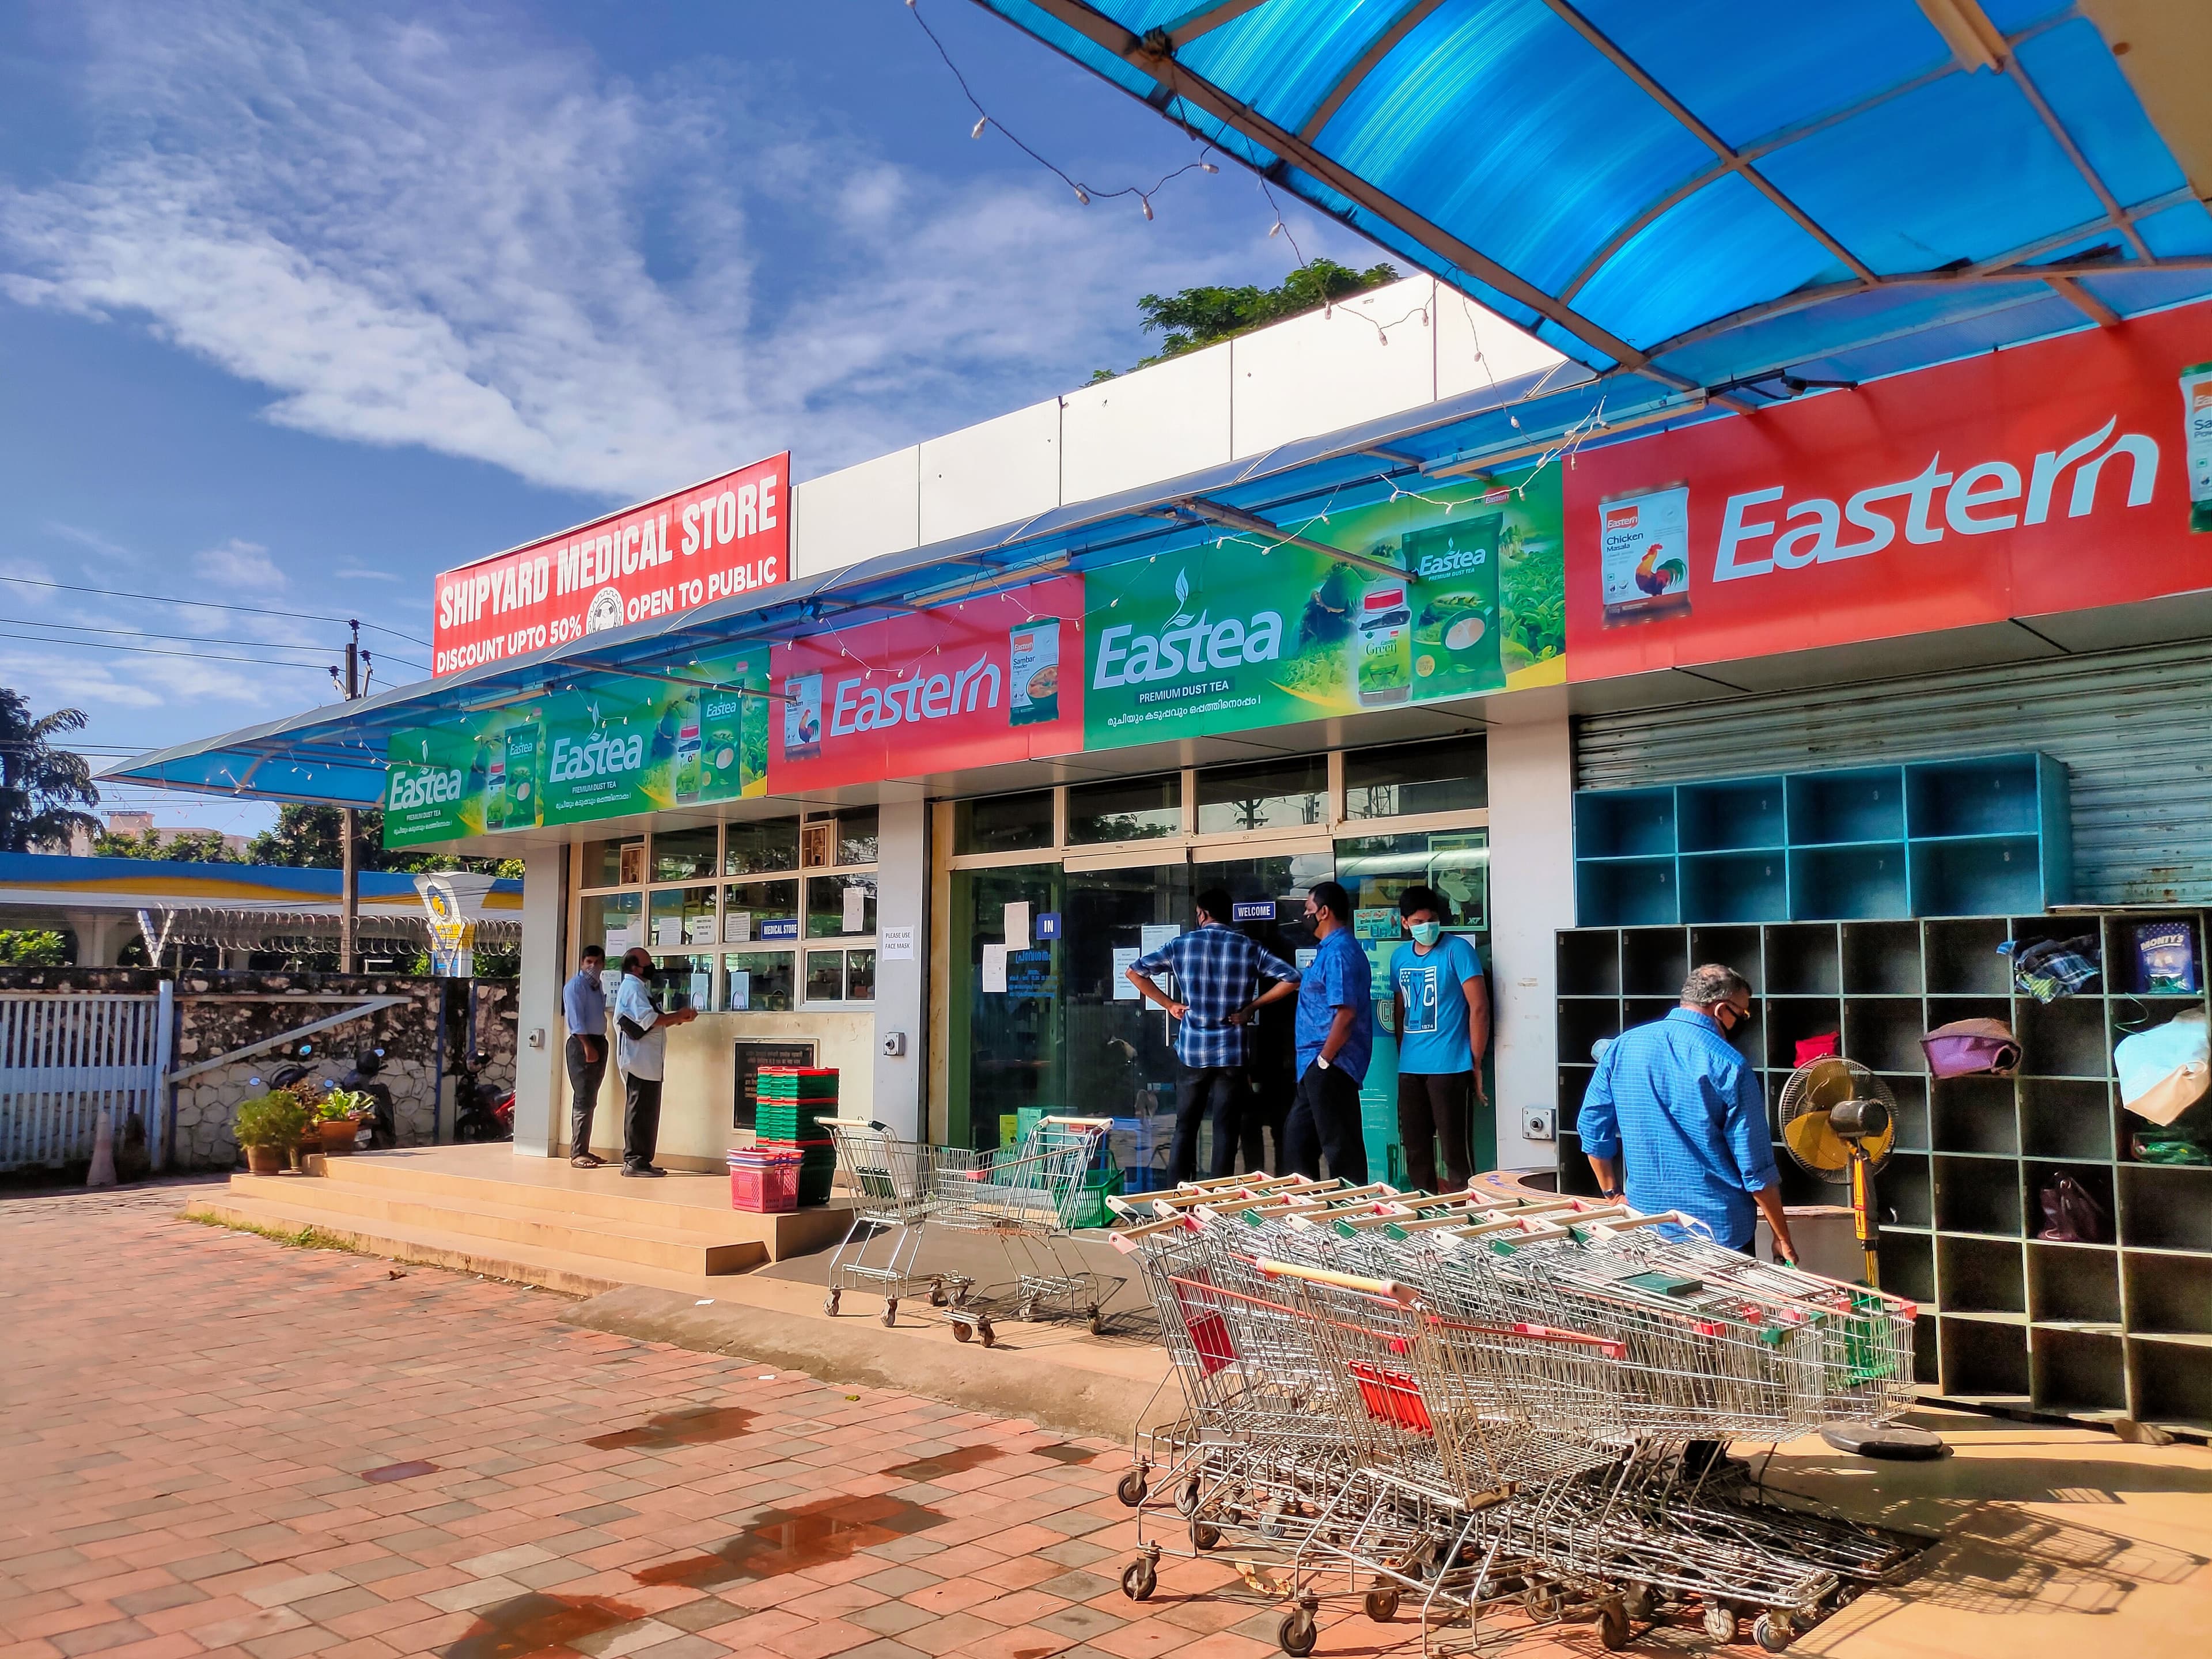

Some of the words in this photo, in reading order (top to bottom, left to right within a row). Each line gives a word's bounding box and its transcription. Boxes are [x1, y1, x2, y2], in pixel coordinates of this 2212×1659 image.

[1713, 415, 2159, 582] Eastern
[1607, 515, 1638, 528] Eastern
[1607, 532, 1644, 546] Chicken
[440, 556, 549, 629] SHIPYARD
[556, 513, 673, 596] MEDICAL
[681, 474, 777, 556] STORE
[1607, 543, 1630, 553] Masala
[1419, 548, 1486, 577] Eastea
[1429, 573, 1451, 581] PREMIUM
[627, 586, 673, 622] OPEN
[679, 578, 703, 608] TO
[709, 556, 778, 601] PUBLIC
[437, 635, 505, 673] DISCOUNT
[507, 624, 546, 655] UPTO
[550, 614, 582, 644] 50%
[1093, 609, 1283, 690] Eastea
[1366, 642, 1397, 656] Green
[1013, 656, 1036, 666] Sambar
[830, 651, 1001, 737] Eastern
[1139, 688, 1180, 703] PREMIUM
[1182, 684, 1207, 698] DUST
[1210, 680, 1229, 692] TEA
[706, 700, 737, 718] Eastea
[510, 742, 533, 756] Eastea
[549, 732, 643, 783] Eastea
[389, 767, 462, 811] Eastea
[572, 784, 593, 794] PREMIUM
[593, 782, 606, 791] DUST
[607, 781, 616, 789] TEA
[423, 810, 433, 819] DUST
[1238, 906, 1271, 917] WELCOME
[764, 925, 783, 935] MEDICAL
[783, 924, 797, 934] STORE
[1044, 919, 1054, 933] IN
[2140, 933, 2184, 950] MONTY'S
